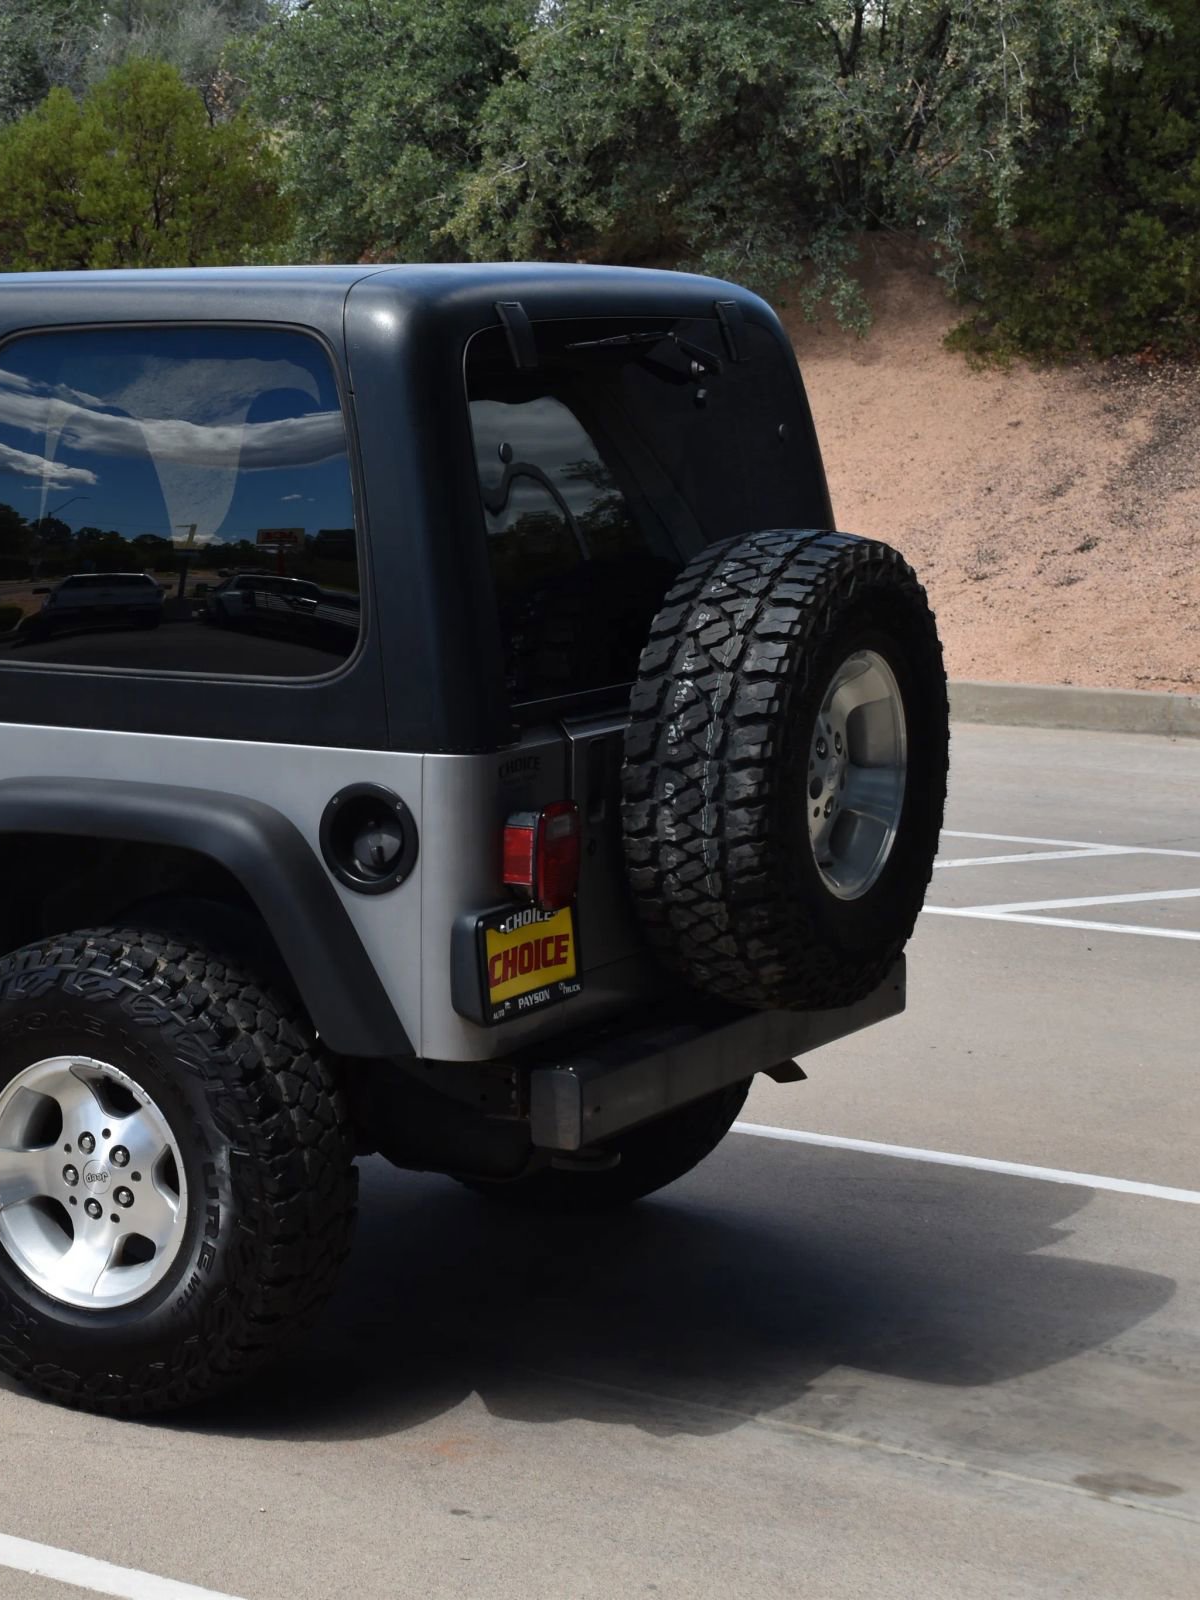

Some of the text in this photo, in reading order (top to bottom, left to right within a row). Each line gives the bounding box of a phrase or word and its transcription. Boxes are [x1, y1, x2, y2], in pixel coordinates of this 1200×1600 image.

[498, 755, 541, 778] CHOICE
[488, 933, 570, 988] CHOICE
[517, 988, 551, 1010] PAYSON
